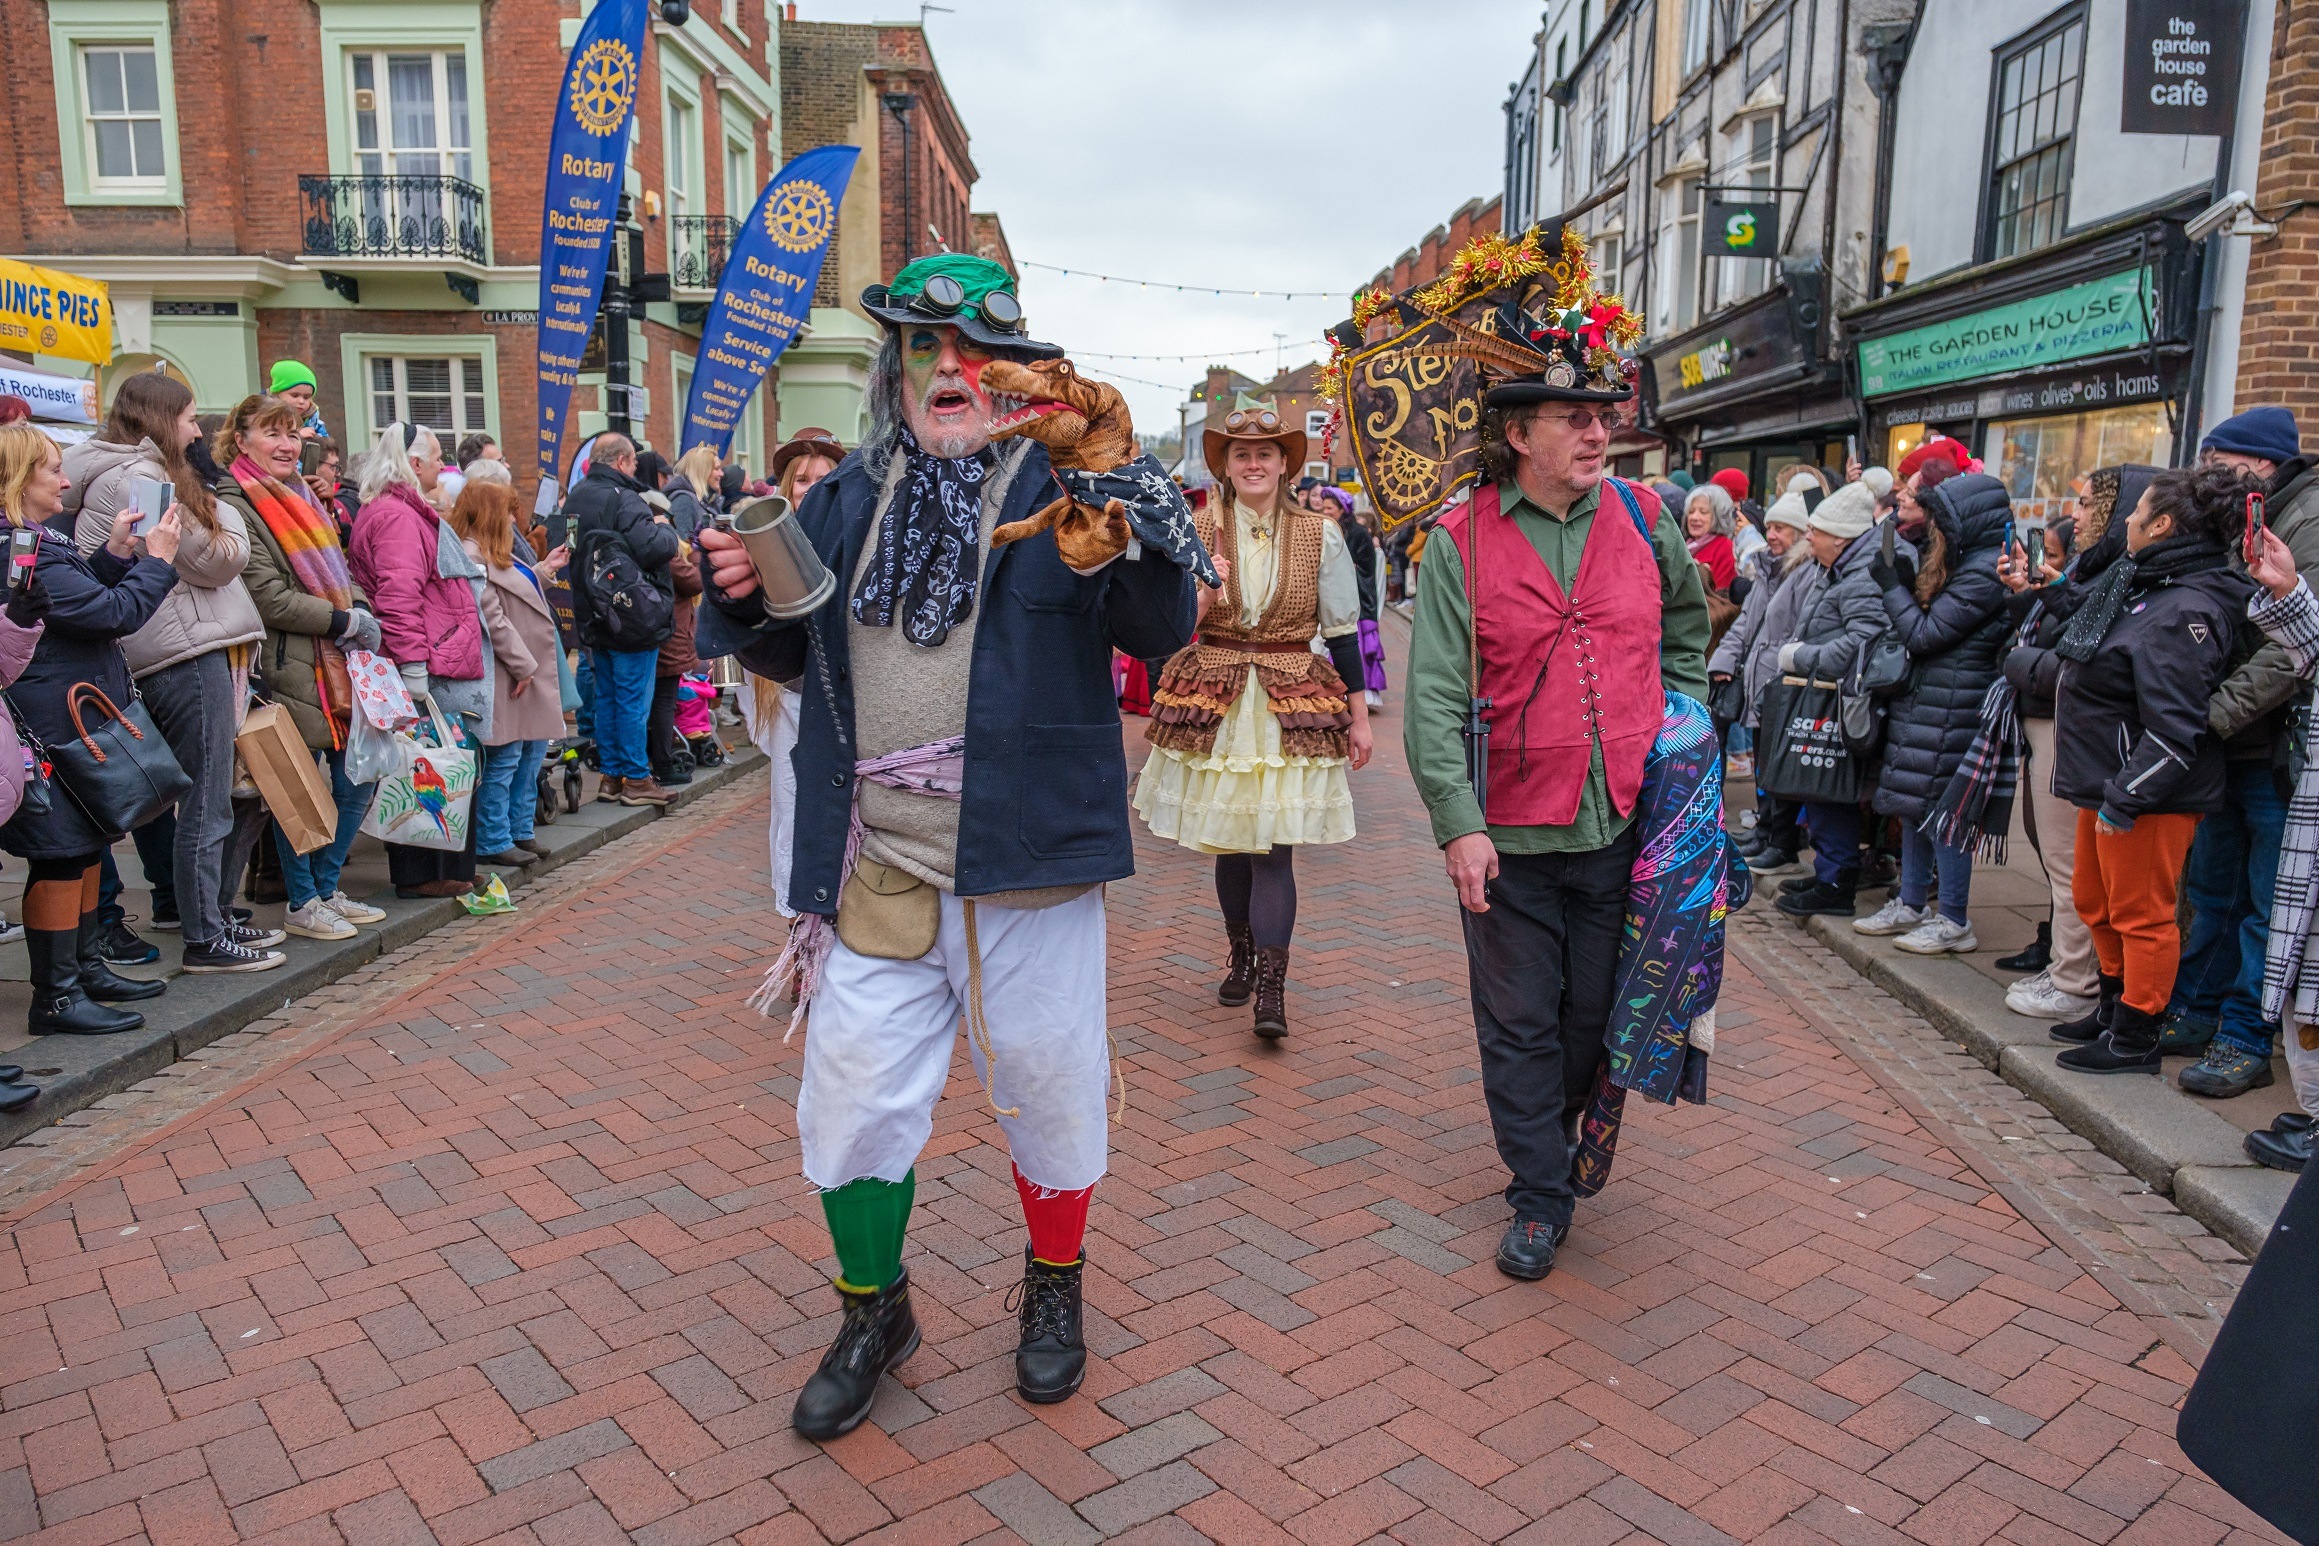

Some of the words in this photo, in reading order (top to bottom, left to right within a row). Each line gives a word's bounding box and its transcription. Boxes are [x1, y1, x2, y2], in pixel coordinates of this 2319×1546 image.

[2168, 16, 2196, 36] the
[2152, 36, 2211, 57] garden
[2154, 55, 2207, 76] house
[561, 153, 615, 183] Rotary
[569, 196, 592, 210] Club
[592, 199, 601, 210] of
[549, 209, 610, 233] Rochester
[745, 255, 807, 293] Rotary
[57, 290, 100, 328] PIES
[750, 288, 771, 303] Club
[772, 297, 784, 307] of
[495, 311, 509, 322] LA
[723, 291, 800, 329] Rochester
[726, 310, 766, 332] Founded
[766, 324, 790, 340] 1928
[1889, 344, 1922, 364] THE
[1929, 323, 2019, 356] GARDEN
[2030, 294, 2125, 333] HOUSE
[723, 331, 772, 358] Service
[1889, 365, 1932, 380] ITALIAN
[1936, 345, 2030, 371] RESTAURANT
[2053, 320, 2133, 349] PIZZERIA
[707, 347, 747, 369] above
[10, 380, 76, 404] Rochester
[713, 379, 739, 395] We're
[2006, 388, 2034, 410] wines
[2040, 381, 2075, 406] olives
[2084, 374, 2107, 401] oils
[2115, 372, 2160, 398] hams
[1790, 743, 1848, 758] savers.co.uk
